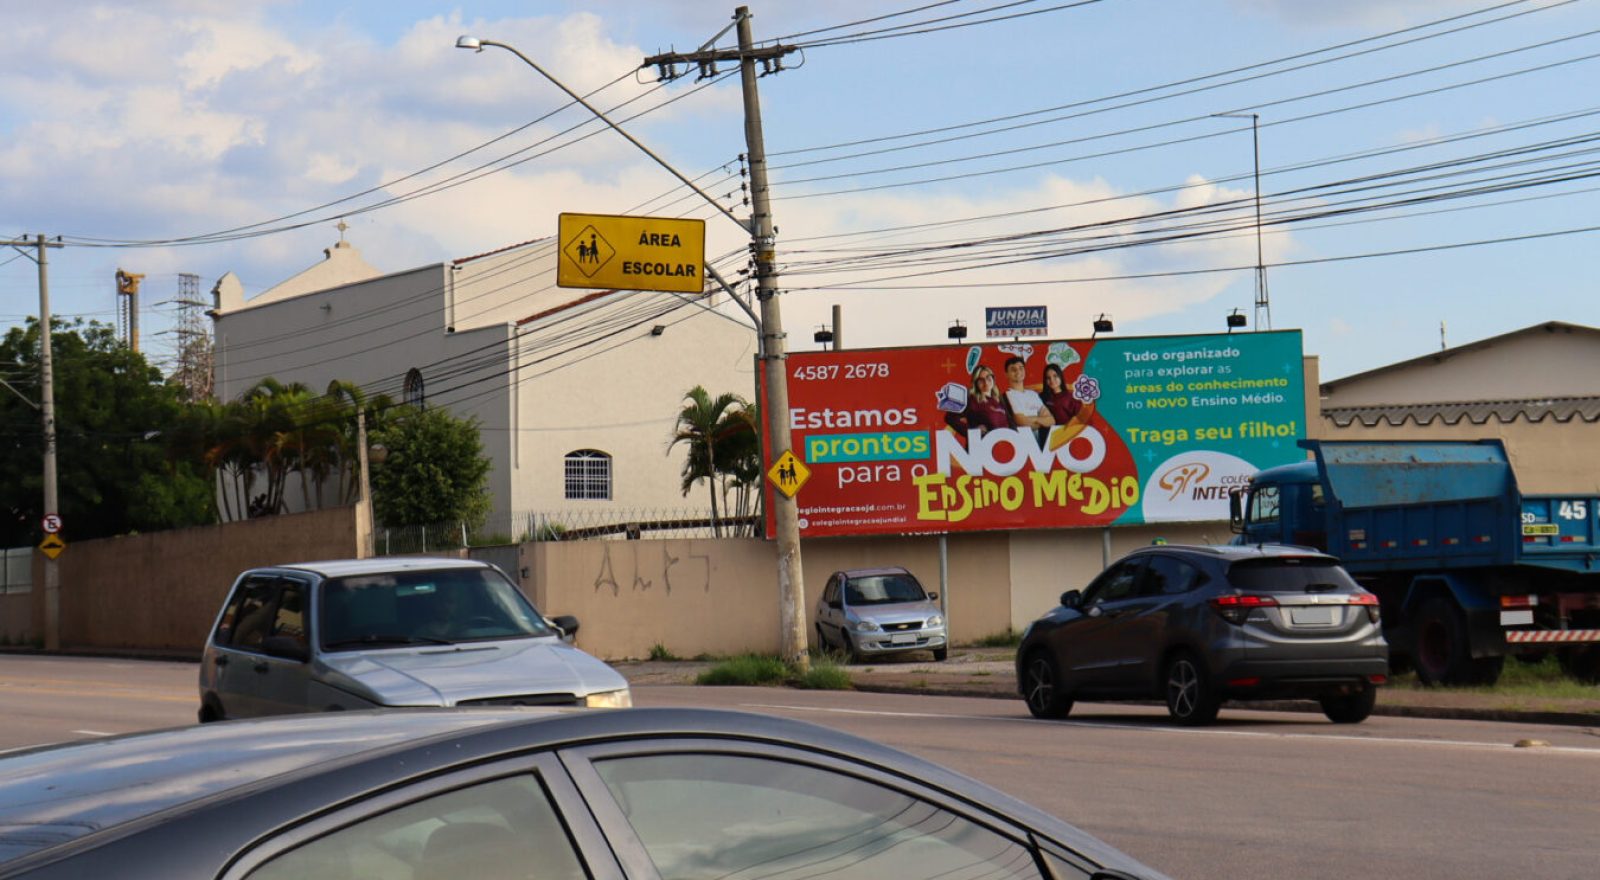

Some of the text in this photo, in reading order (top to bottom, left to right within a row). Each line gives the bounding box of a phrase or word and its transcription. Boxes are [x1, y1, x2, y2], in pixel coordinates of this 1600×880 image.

[639, 230, 681, 247] ÁREA
[622, 261, 696, 277] ESCOLAR
[1123, 347, 1240, 363] Tudo organizado
[793, 364, 890, 380] 4587 2678
[1125, 364, 1232, 379] para explorar as
[1125, 376, 1288, 393] áreas do conhecimento
[1126, 400, 1143, 410] no
[1146, 398, 1188, 408] NOVO
[1191, 394, 1237, 406] Ensino
[790, 407, 918, 429] Estamos
[1127, 421, 1297, 446] Traga seu filho!
[810, 434, 927, 462] prontos
[936, 424, 1106, 477] NOVO
[838, 463, 928, 488] para o
[1559, 501, 1587, 520] 45
